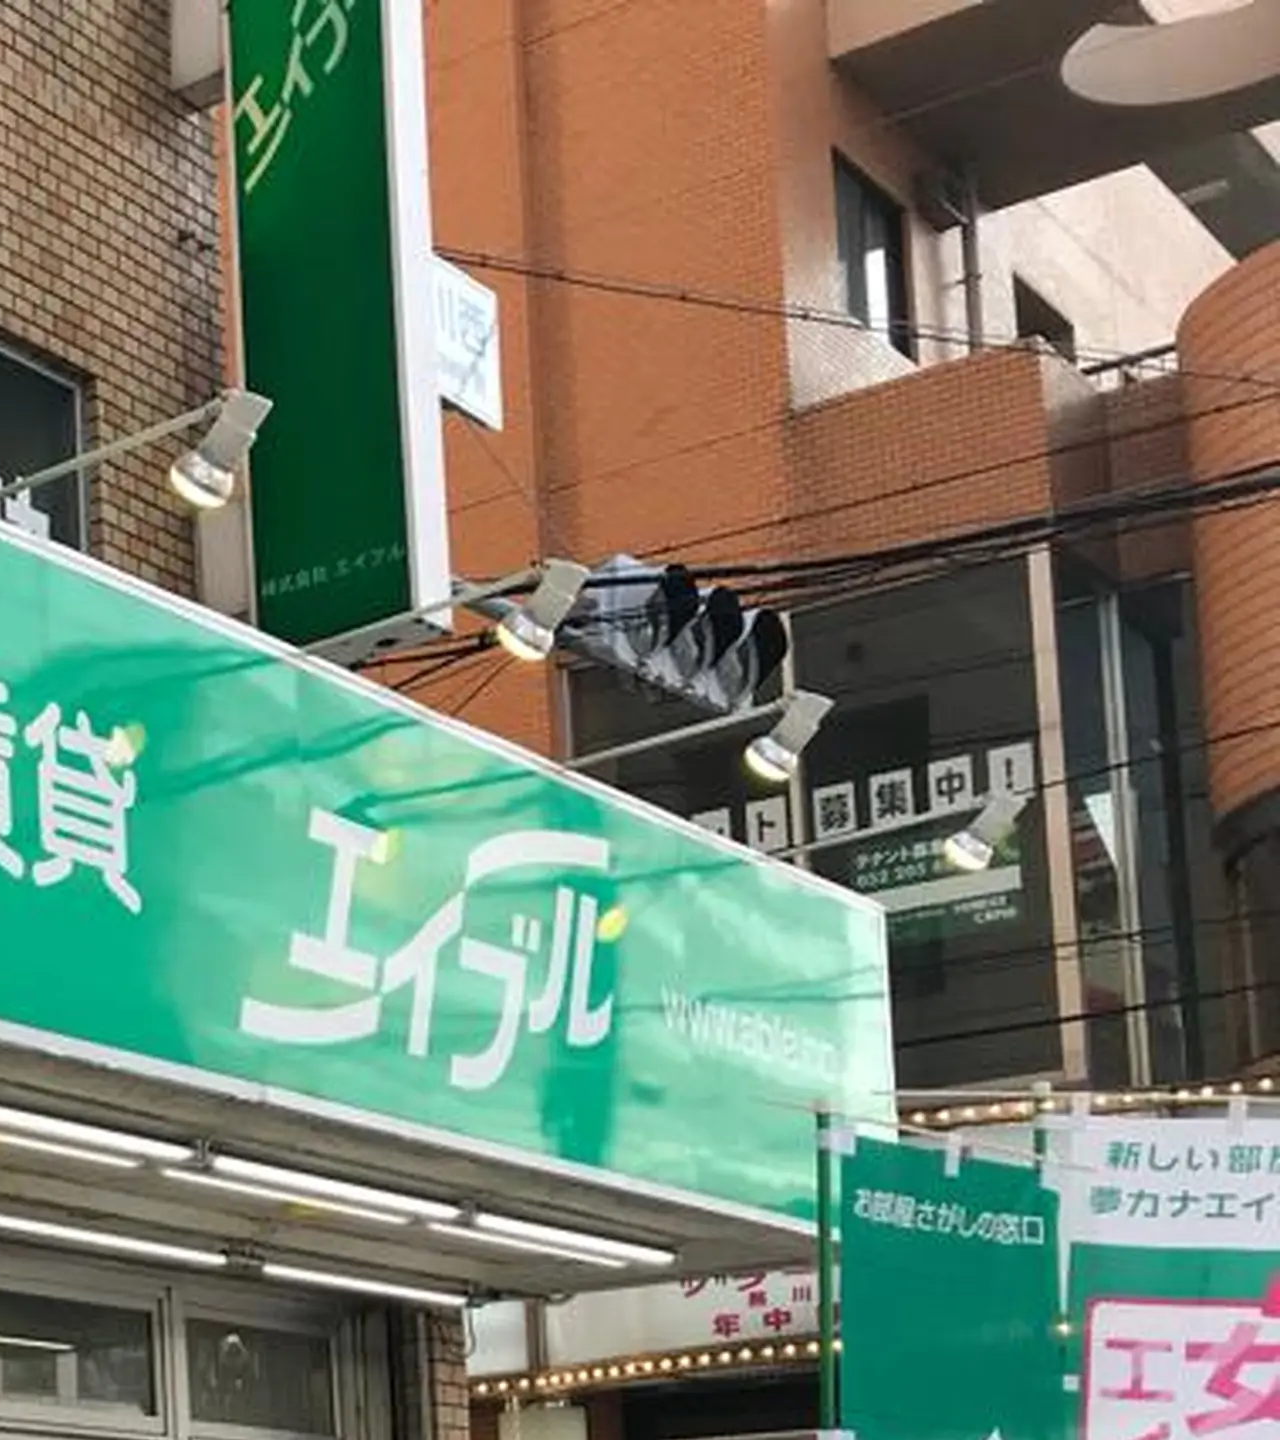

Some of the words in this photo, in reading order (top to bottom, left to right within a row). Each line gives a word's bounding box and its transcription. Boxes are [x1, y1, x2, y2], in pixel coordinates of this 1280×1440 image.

[234, 0, 355, 193] エイブ
[240, 806, 612, 1090] エイブル
